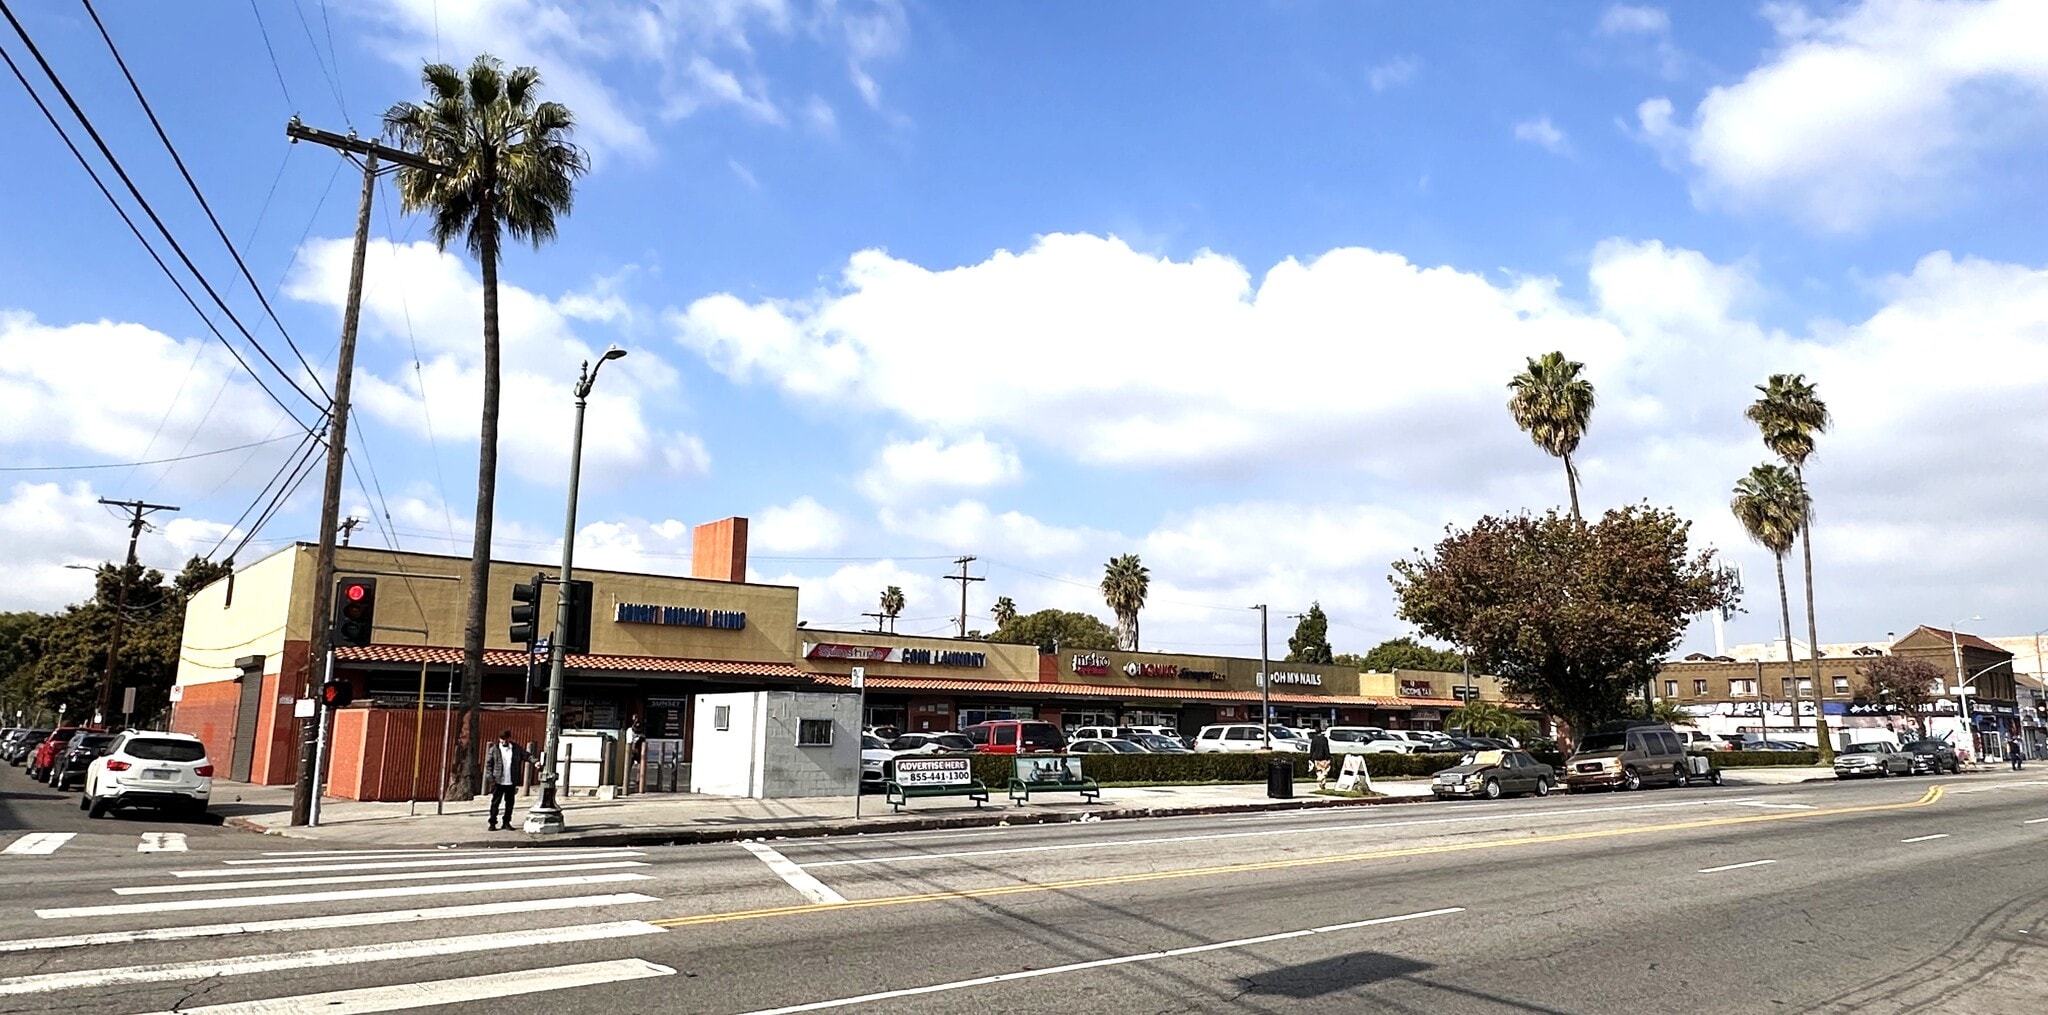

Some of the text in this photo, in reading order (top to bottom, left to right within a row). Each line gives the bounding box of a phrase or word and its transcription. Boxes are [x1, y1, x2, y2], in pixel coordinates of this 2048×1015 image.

[818, 645, 884, 659] Sunshine
[902, 648, 986, 667] COIN LAUNDRY
[1073, 653, 1110, 671] metro
[1273, 671, 1286, 684] OH
[1300, 673, 1321, 686] NAILS
[900, 761, 965, 771] ADVERTISE HERE
[910, 771, 969, 781] 855-441-1300
